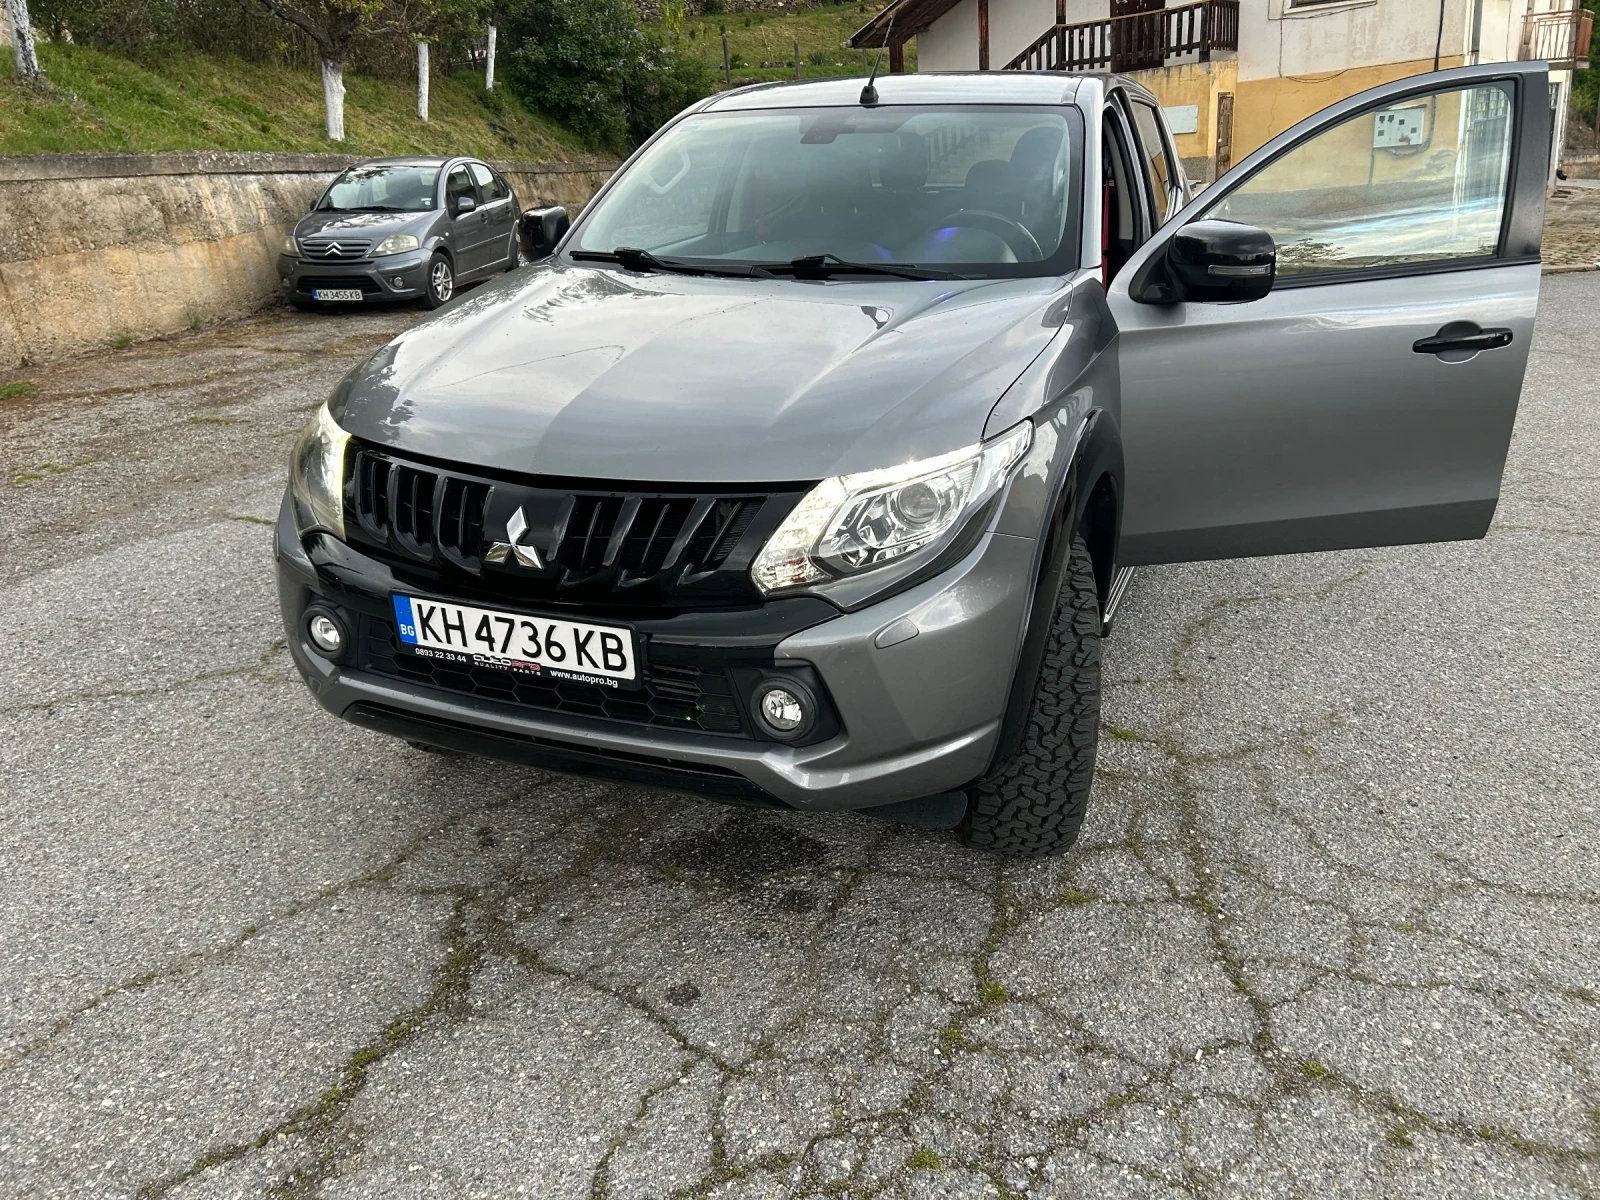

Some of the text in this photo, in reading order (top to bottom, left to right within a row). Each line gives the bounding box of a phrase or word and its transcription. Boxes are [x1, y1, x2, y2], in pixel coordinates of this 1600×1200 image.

[400, 624, 415, 637] BG
[415, 648, 433, 657] 0893
[434, 651, 445, 659] 22
[446, 652, 456, 661] 33
[474, 661, 541, 676] QUALITY PARTS
[550, 669, 618, 688] www.autopro.bg
